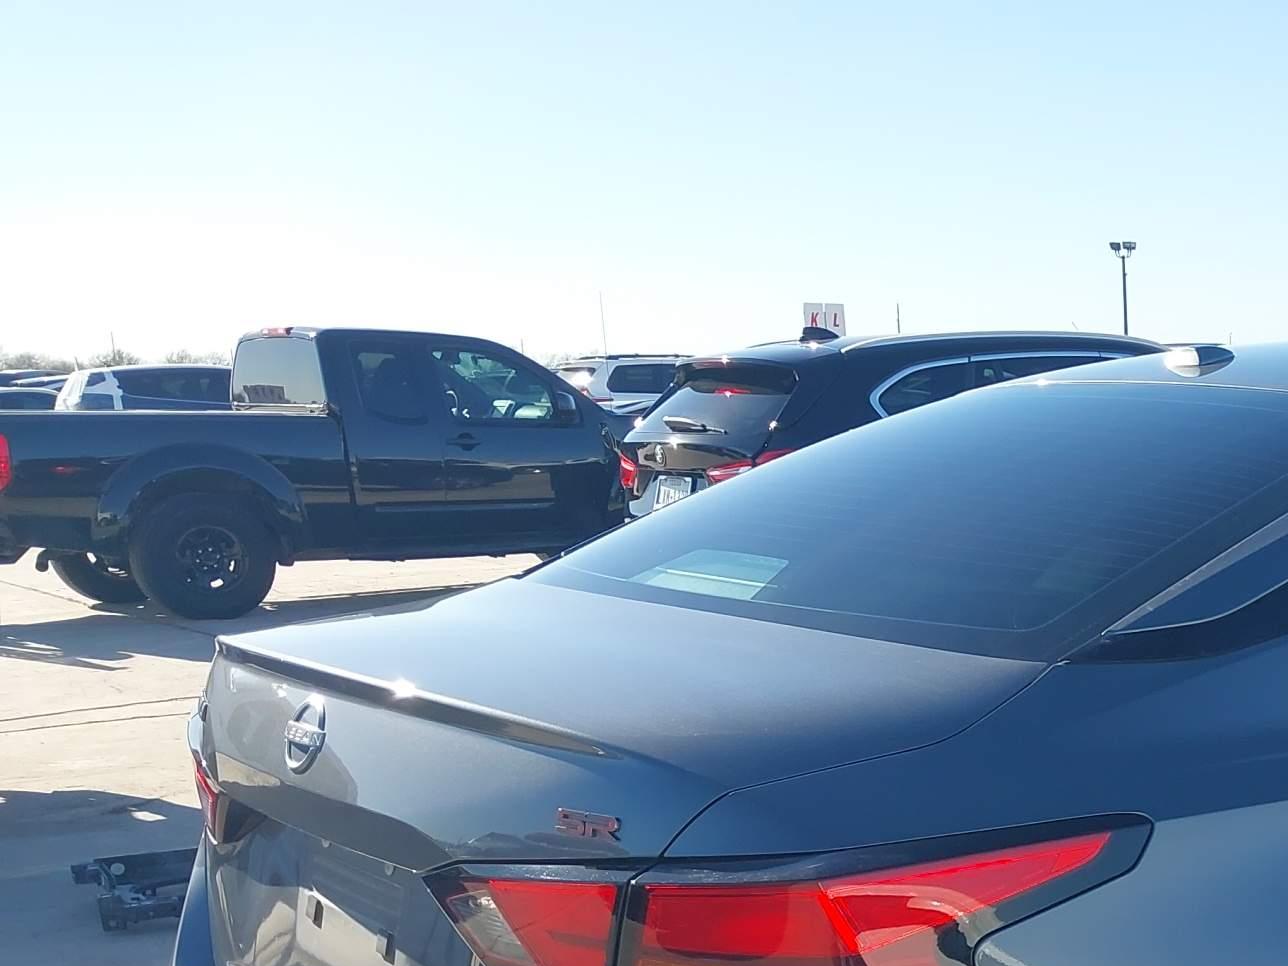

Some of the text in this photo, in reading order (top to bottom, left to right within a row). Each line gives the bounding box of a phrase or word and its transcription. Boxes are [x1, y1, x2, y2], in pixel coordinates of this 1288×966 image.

[810, 311, 820, 327] K
[833, 312, 840, 327] L
[556, 807, 619, 840] SR
